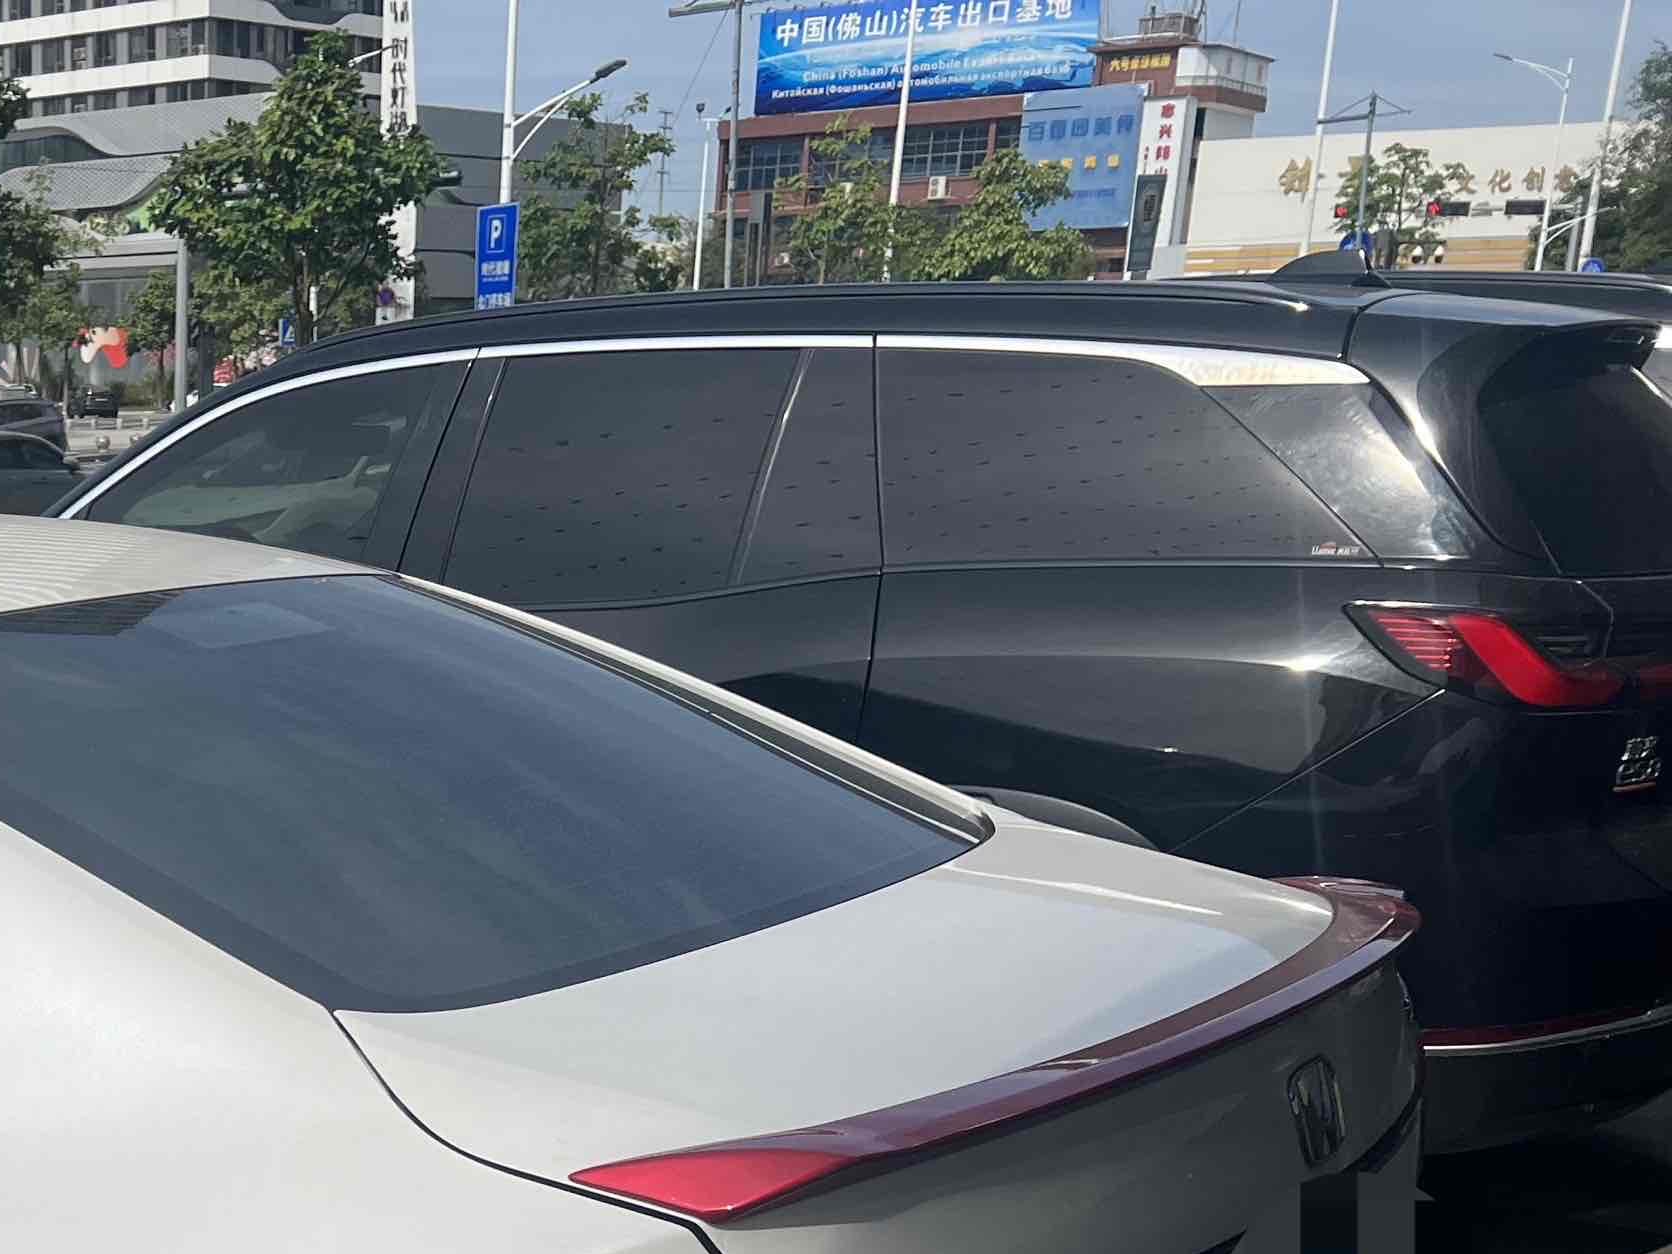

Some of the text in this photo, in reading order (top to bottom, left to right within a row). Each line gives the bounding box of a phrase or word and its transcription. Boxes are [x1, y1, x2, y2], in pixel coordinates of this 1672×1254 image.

[803, 70, 836, 82] China
[838, 66, 888, 80] (Foshan)
[891, 58, 962, 75] Auomobile
[490, 219, 503, 249] P
